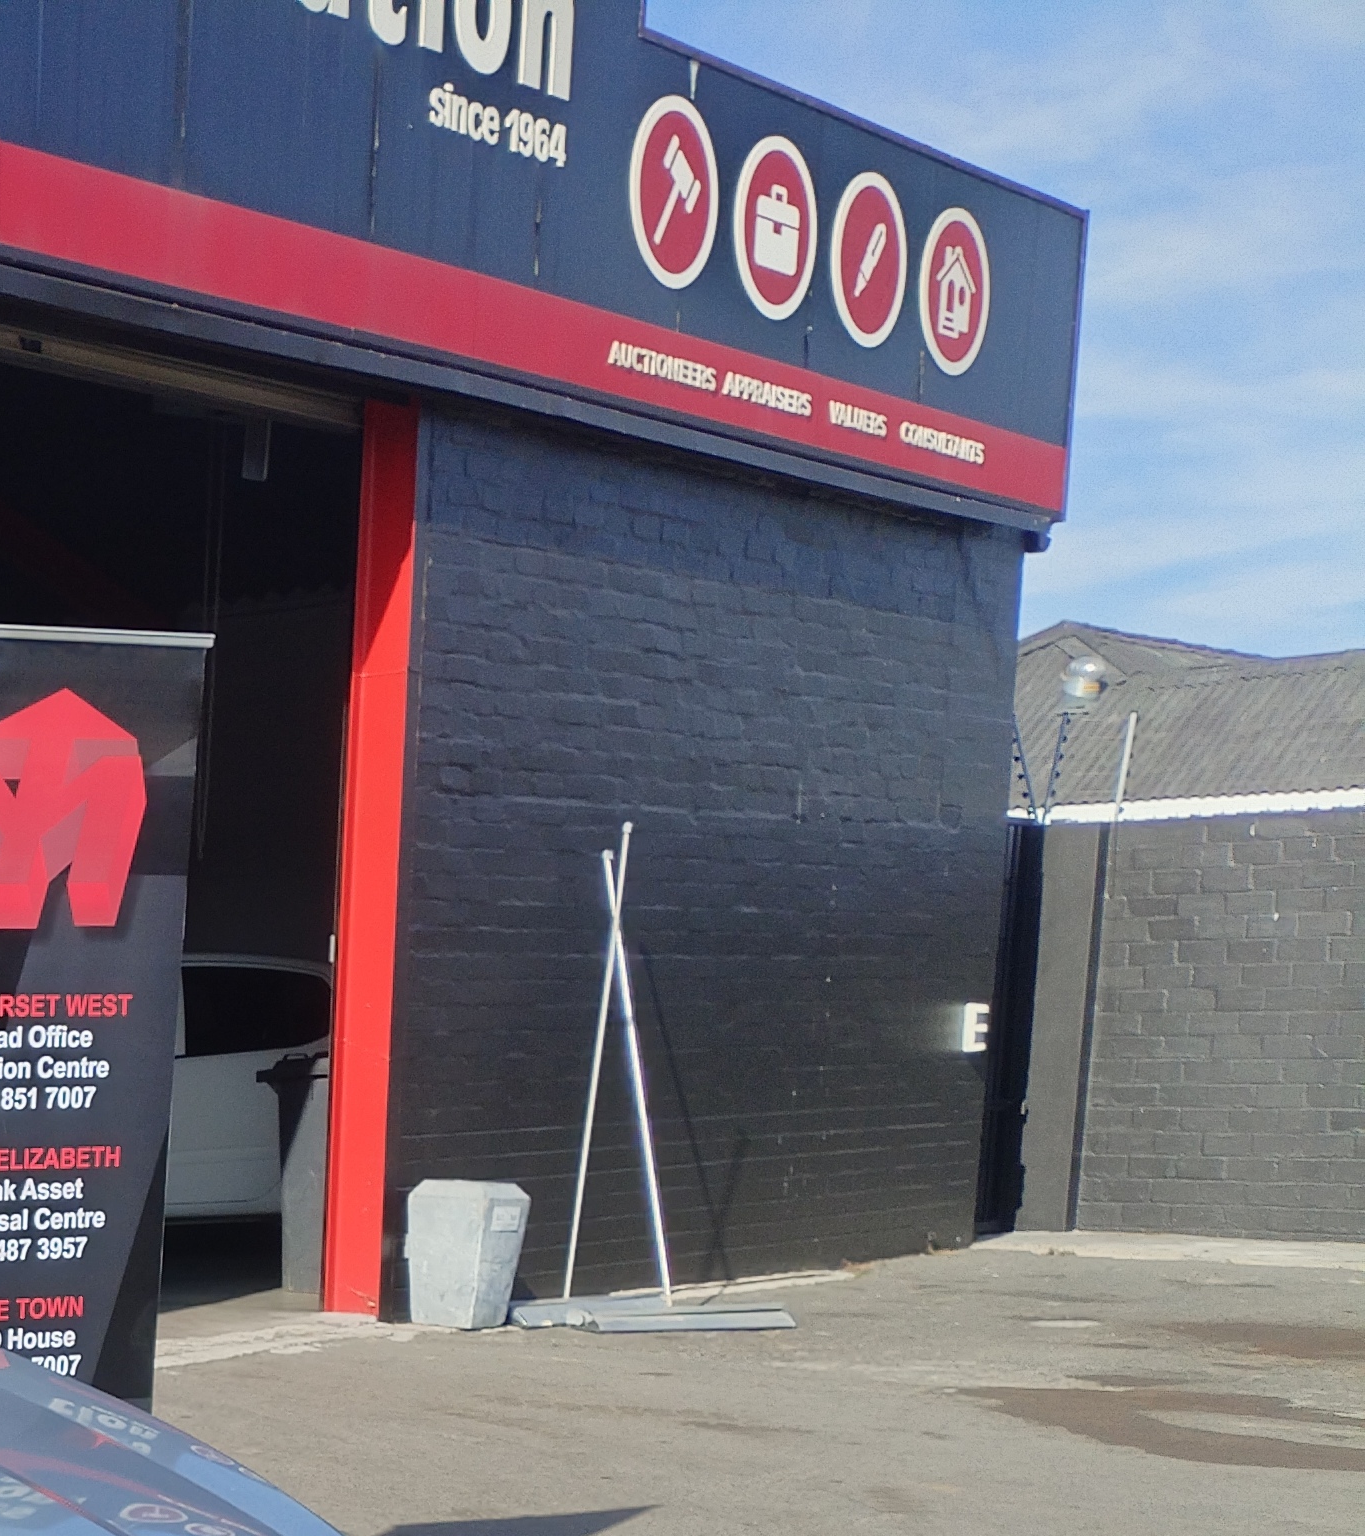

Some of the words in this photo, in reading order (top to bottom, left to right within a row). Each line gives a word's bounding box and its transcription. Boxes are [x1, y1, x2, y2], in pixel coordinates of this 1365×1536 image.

[429, 82, 500, 146] since
[504, 108, 568, 168] 1964
[608, 340, 717, 392] AUCTIONEERS
[722, 371, 813, 417] APPRAISERS
[828, 400, 888, 437] VALUERS
[65, 993, 134, 1018] WEST
[28, 1025, 94, 1048] Office
[37, 1055, 110, 1079] Centre
[0, 1087, 38, 1111] 851
[45, 1085, 97, 1110] 7007
[20, 1177, 84, 1201] Asset
[34, 1207, 107, 1231] Centre
[36, 1236, 89, 1260] 3957
[15, 1295, 85, 1320] TOWN
[7, 1327, 77, 1350] House
